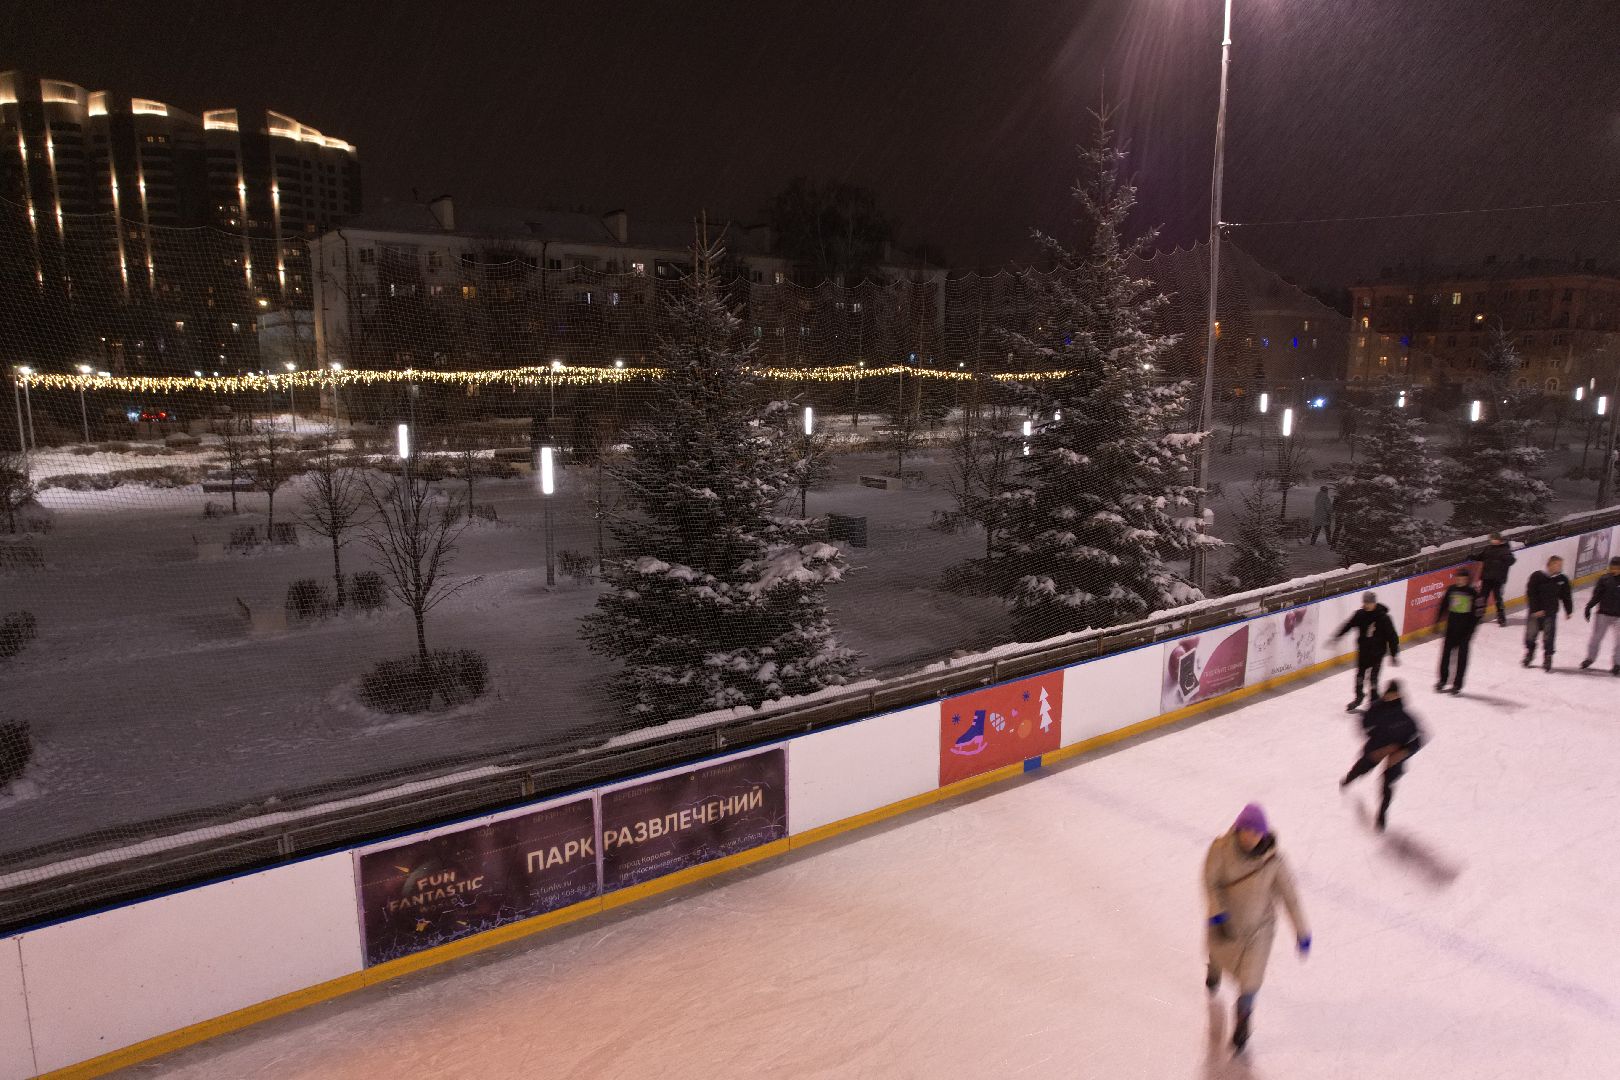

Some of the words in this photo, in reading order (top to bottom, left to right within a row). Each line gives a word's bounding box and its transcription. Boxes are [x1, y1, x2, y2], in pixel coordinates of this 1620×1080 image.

[526, 836, 596, 874] ПАРК
[602, 785, 764, 851] РАЗВЛЕЧЕНИЙ
[388, 875, 485, 913] FANTASTIC
[416, 871, 456, 891] FUN
